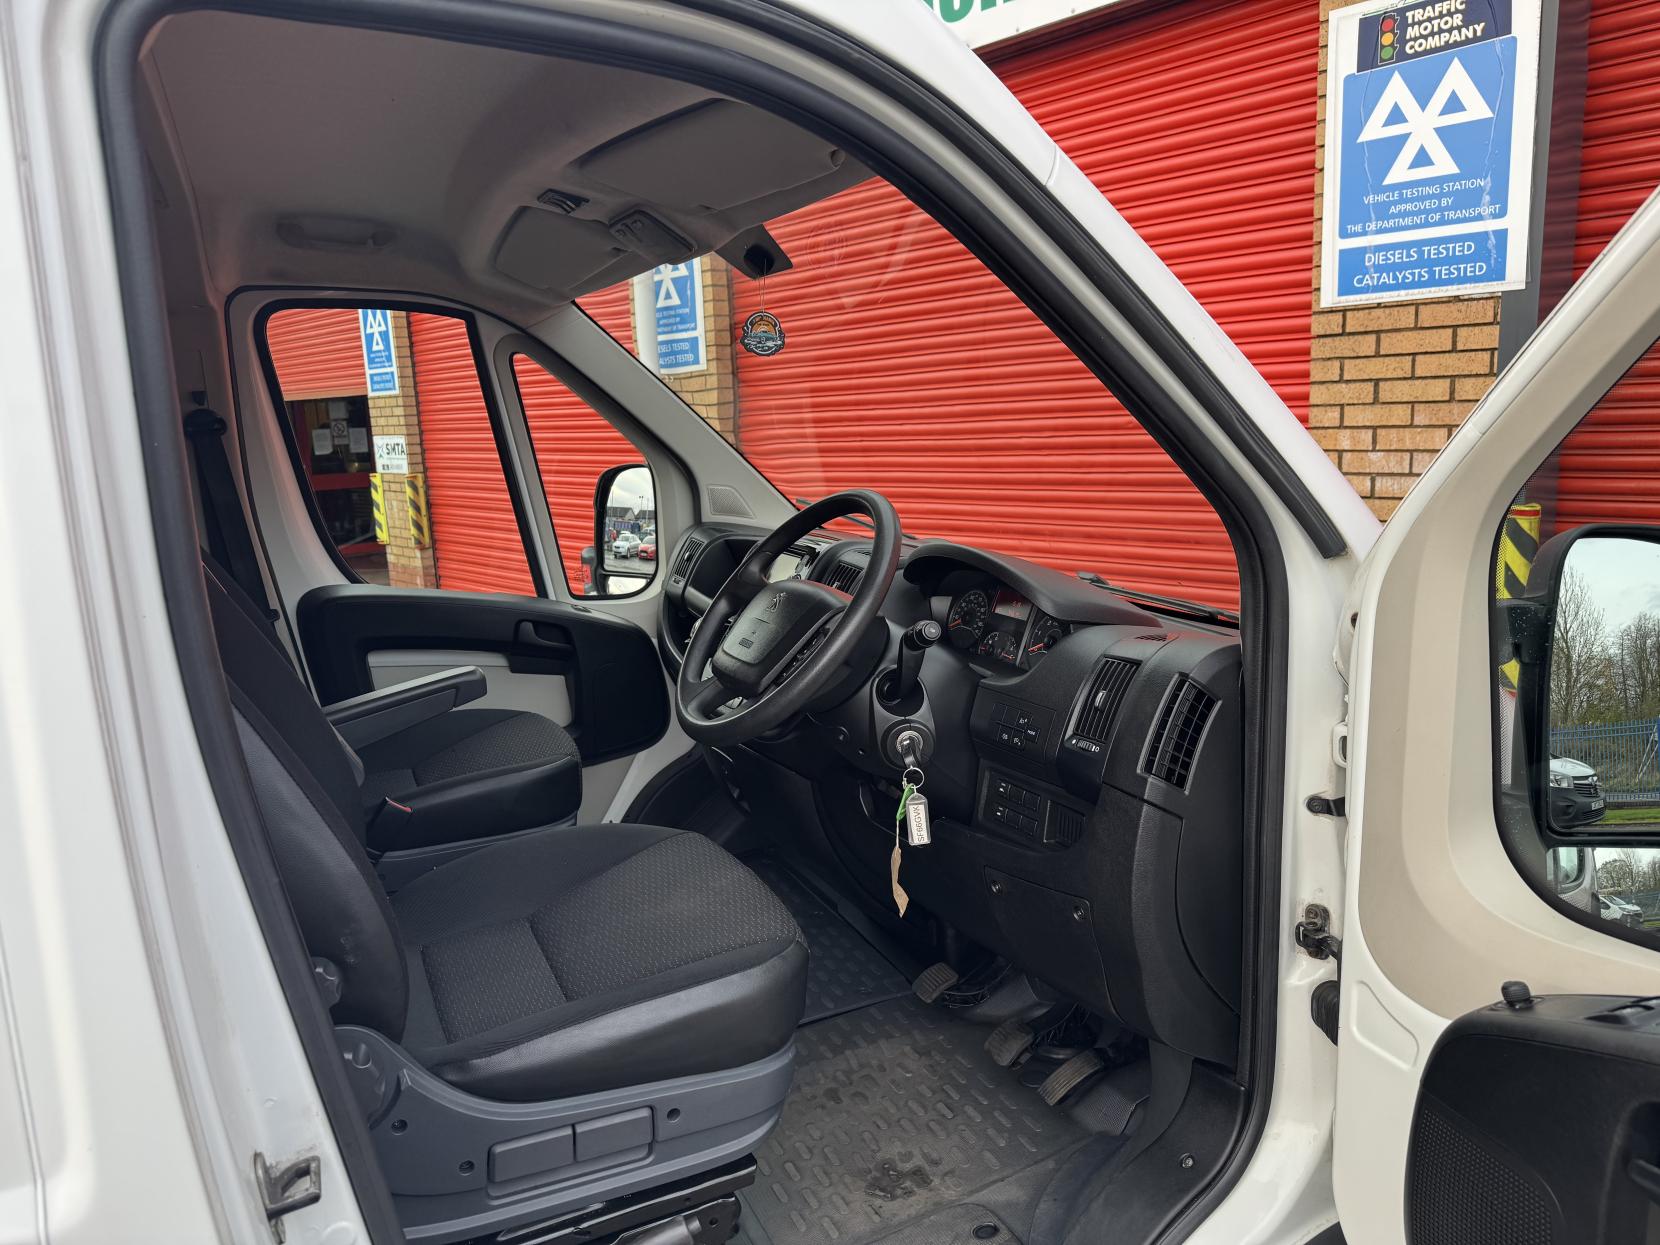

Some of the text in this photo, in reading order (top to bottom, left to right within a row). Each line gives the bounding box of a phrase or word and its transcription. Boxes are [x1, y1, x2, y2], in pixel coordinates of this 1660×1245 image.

[1405, 0, 1466, 24] TRAFFIC
[1405, 13, 1463, 40] MOTOR
[1405, 22, 1486, 54] COMPANY
[1363, 178, 1485, 205] VEHICLE TESTING STATION
[1346, 204, 1501, 233] THE DEPARTMENT OF TRANSPORT
[1389, 197, 1454, 215] APPROVED BY
[1365, 242, 1475, 266] DIESELS TESTED
[1353, 262, 1487, 288] CATALYSTS TESTED
[385, 442, 406, 456] SMTA
[912, 805, 925, 843] SF66GVK
